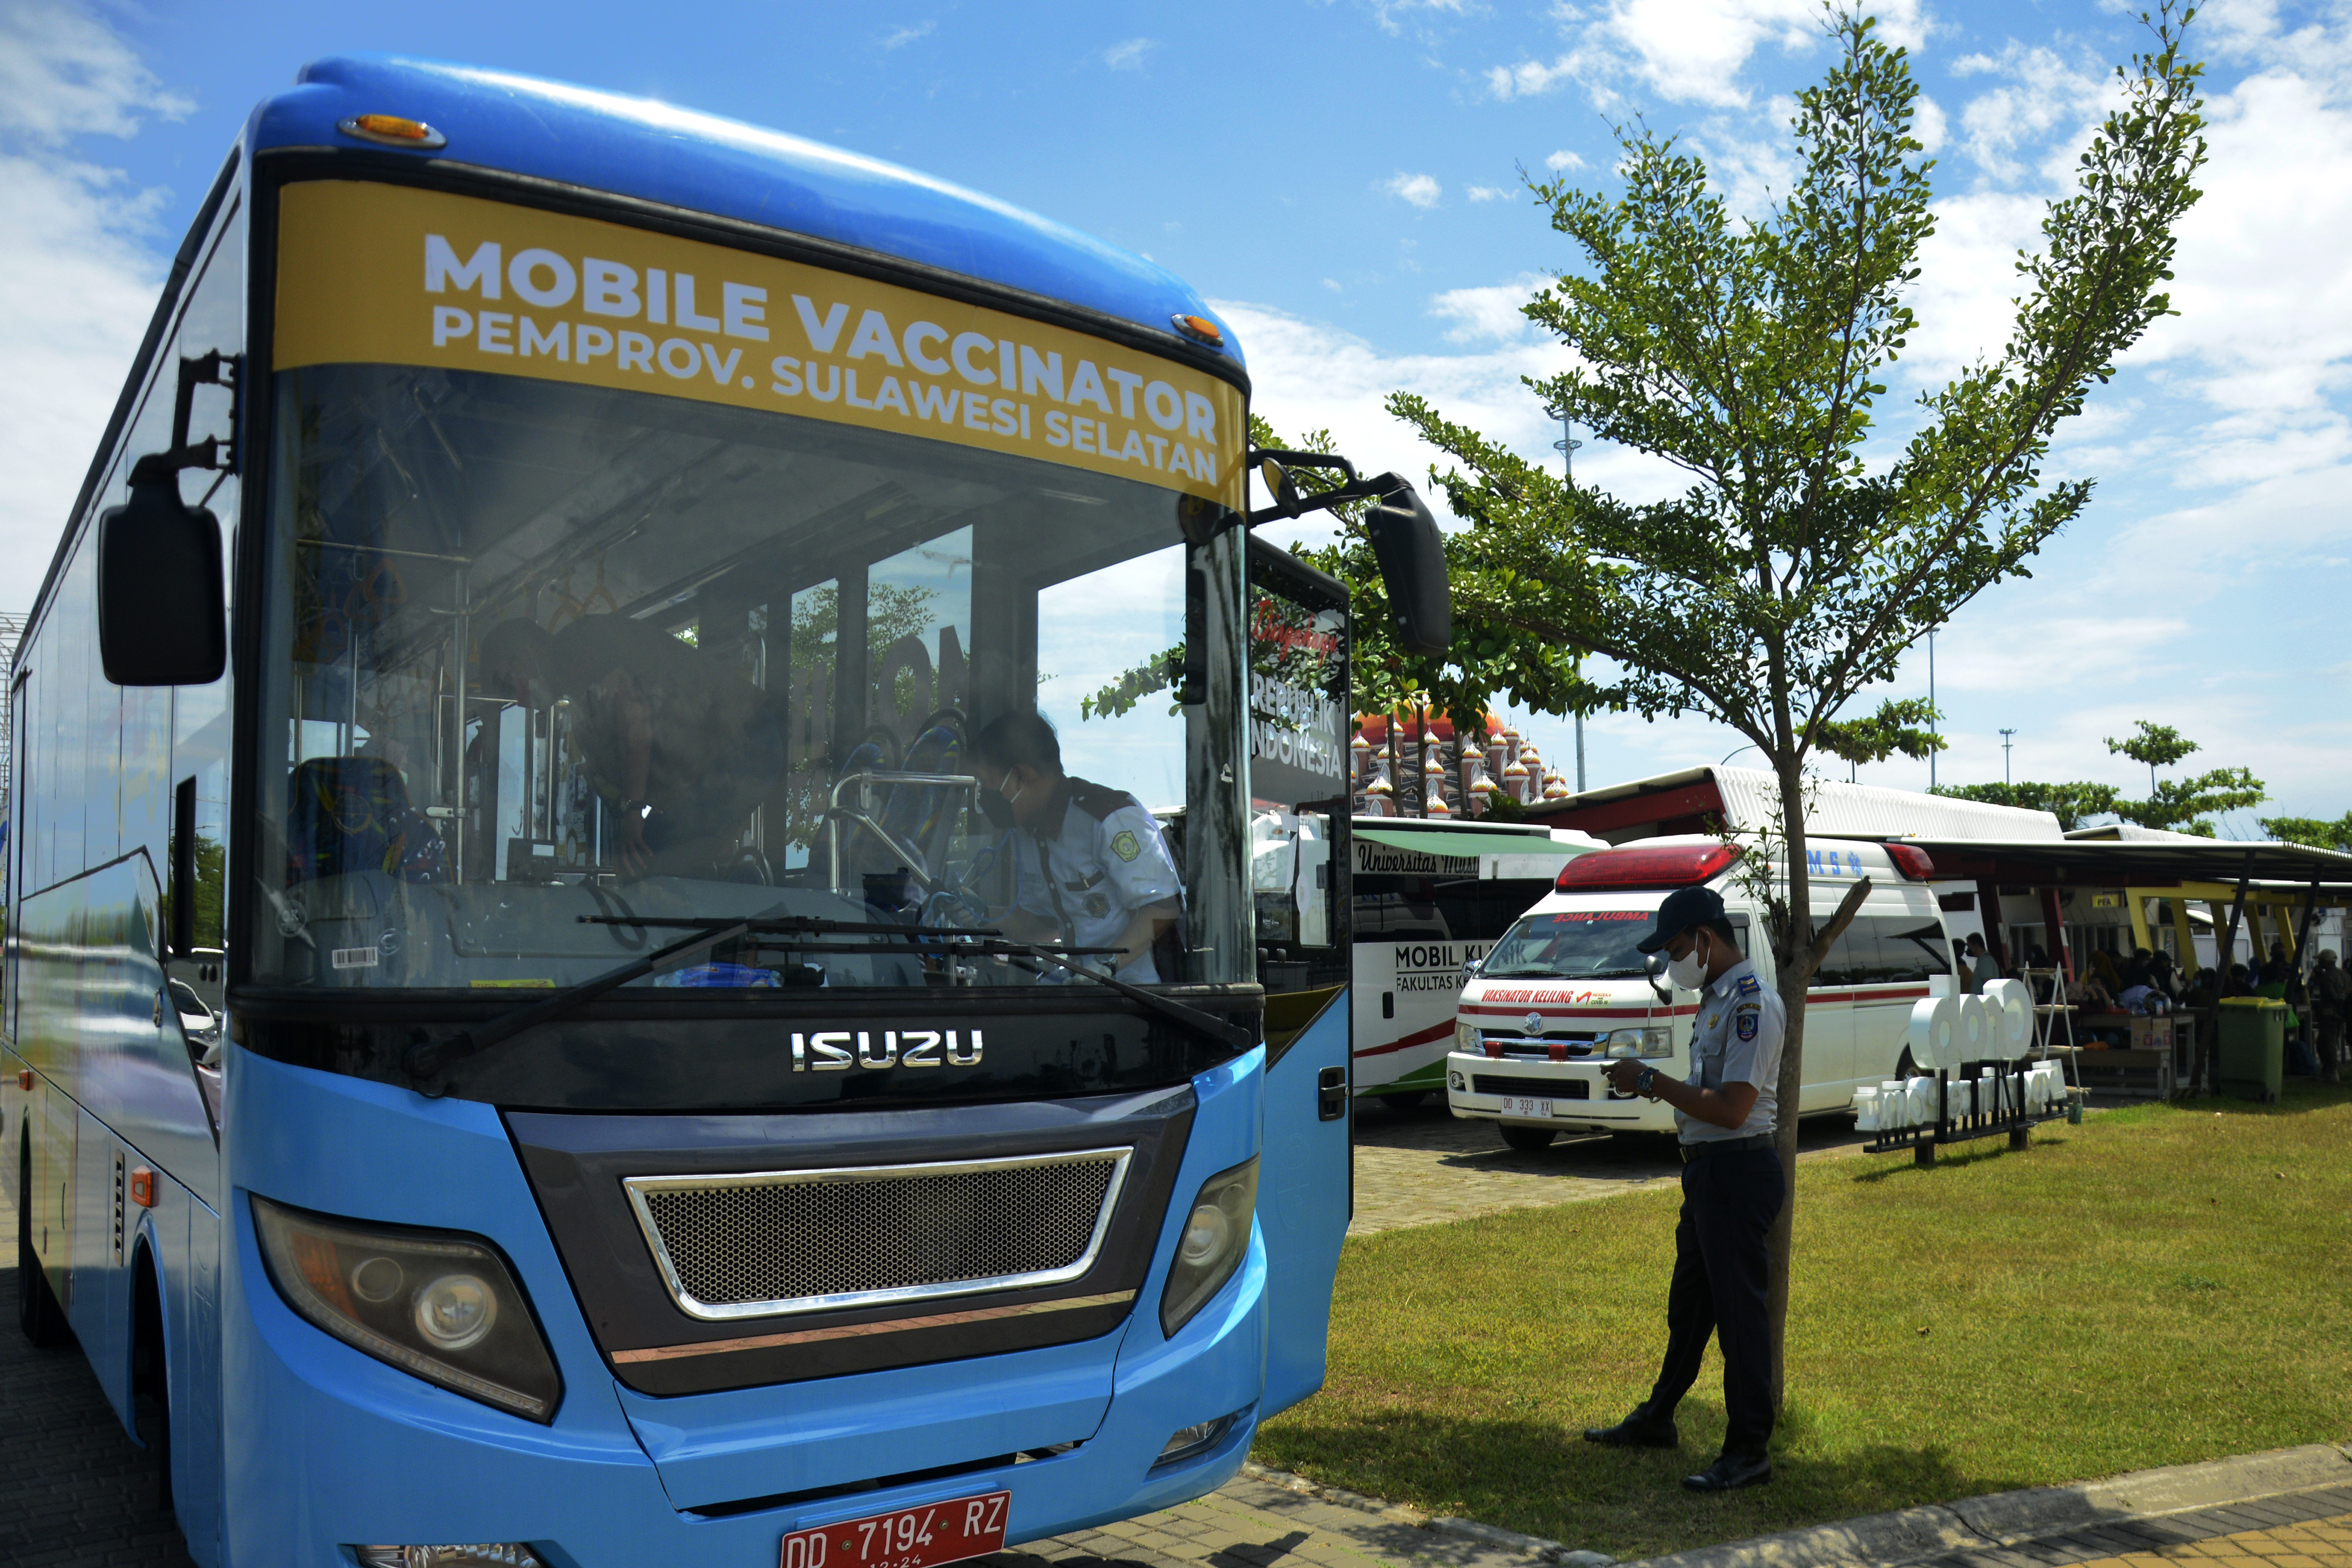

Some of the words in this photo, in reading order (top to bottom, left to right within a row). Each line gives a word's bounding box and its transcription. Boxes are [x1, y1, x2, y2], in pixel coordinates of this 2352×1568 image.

[425, 233, 769, 342] MOBILE
[791, 293, 1217, 444] VACCINATOR
[433, 305, 754, 389] PEMPROV.
[771, 356, 1030, 440] SULAWESI
[1045, 410, 1217, 487] SELATAN
[1252, 599, 1338, 668] Dirgahayu
[1252, 671, 1336, 735] REPUBLIK
[1251, 718, 1343, 780] NDONESIA
[1358, 844, 1437, 873] Universitas
[1396, 945, 1459, 968] MOBIL
[1396, 975, 1452, 992] FAKULTAS
[1481, 989, 1533, 1003] VAKSINATOR
[1532, 990, 1574, 1004] KELILING
[791, 1029, 983, 1072] ISUZU
[1504, 1098, 1512, 1109] DD
[1519, 1099, 1534, 1110] 333
[787, 1532, 827, 1568] DD
[858, 1509, 936, 1560] 7194
[963, 1496, 1005, 1537] RZ
